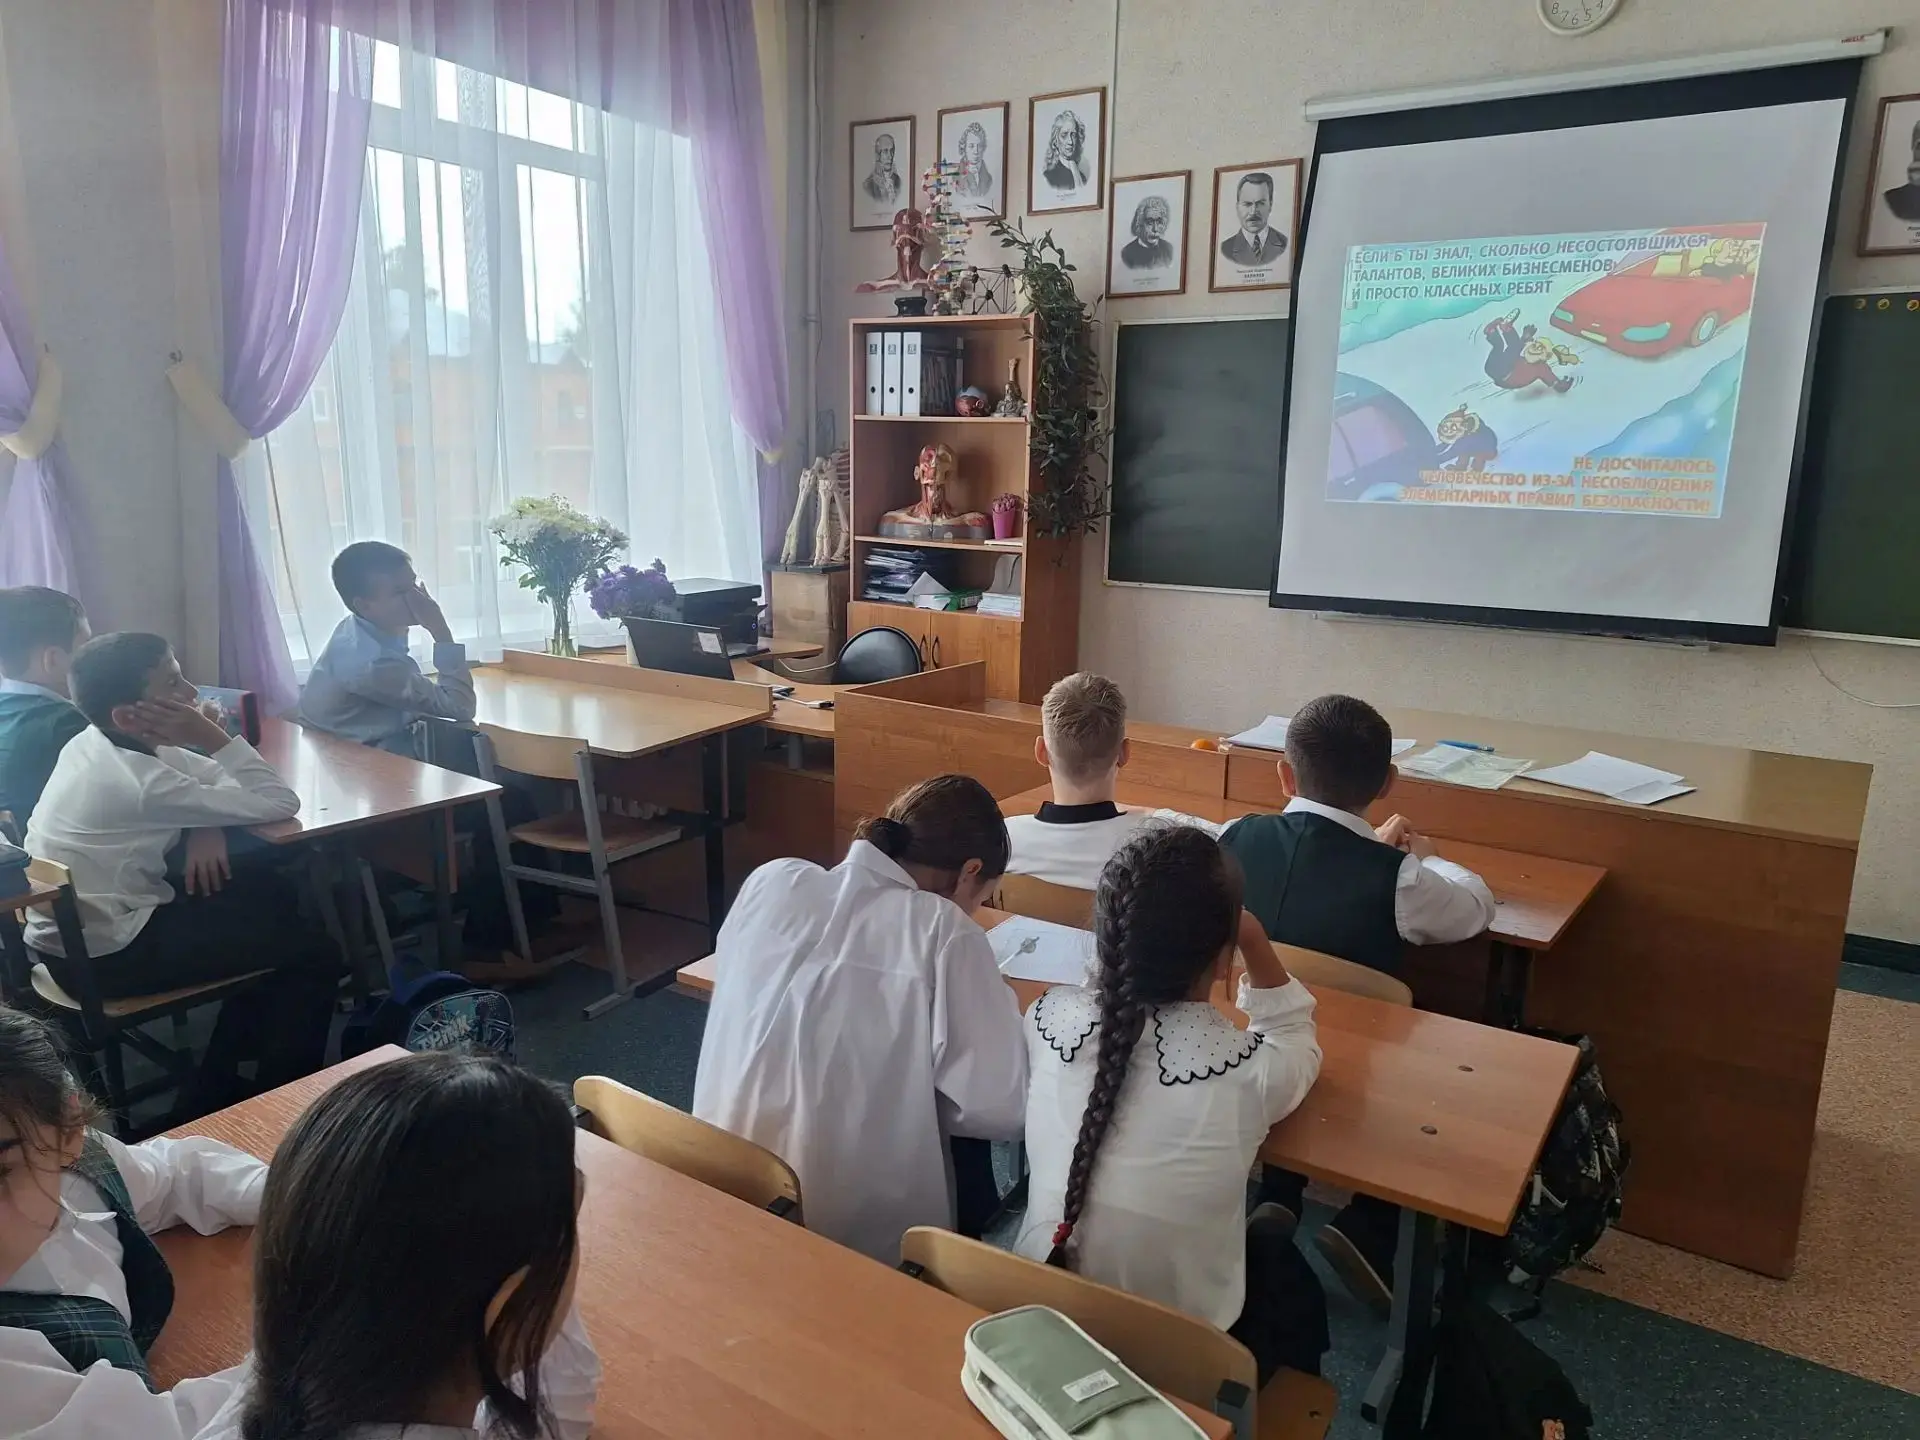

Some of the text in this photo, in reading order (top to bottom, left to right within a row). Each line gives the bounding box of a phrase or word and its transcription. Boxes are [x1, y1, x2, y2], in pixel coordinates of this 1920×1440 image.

[1551, 2, 1560, 15] 8
[1583, 8, 1592, 22] 5
[1561, 10, 1569, 23] 7
[1571, 14, 1579, 25] 6
[1354, 234, 1708, 264] ЕСЛИ Б ТЫ ЗНАЛ, СКОЛЬКО НЕСОСТОЯВШИХСЯ
[1353, 267, 1426, 282] ТАЛАНТОВ,
[1431, 264, 1497, 279] ВЕЛИКИХ
[1352, 280, 1553, 300] И ПРОСТО КЛАССНЫХ РЕБЯТ
[1574, 456, 1717, 473] НЕ ДОСЧИТАЛОСЬ
[1419, 470, 1714, 493] ЛОВЕЧЕСТВО ИЗ-ЗА НЕСОБЛЮДЕНИЯ
[1516, 492, 1576, 506] ПРАВИЛ
